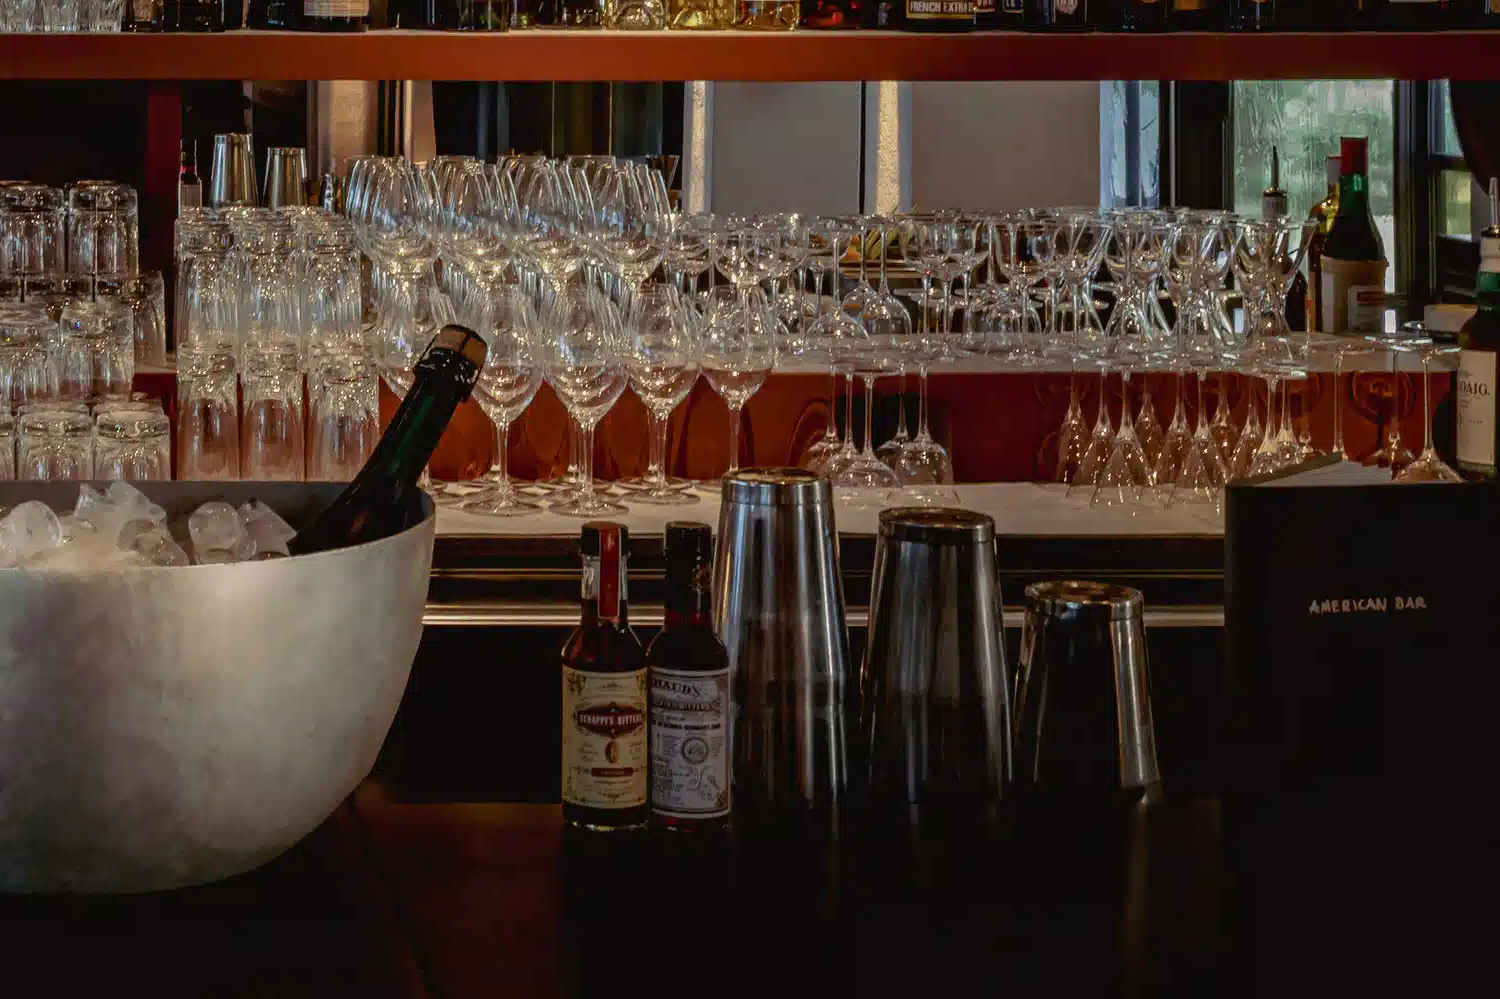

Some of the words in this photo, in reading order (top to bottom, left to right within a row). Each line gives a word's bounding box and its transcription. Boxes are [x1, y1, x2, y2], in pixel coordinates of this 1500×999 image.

[908, 1, 940, 13] FRENCH
[1308, 597, 1388, 616] AMERICAN
[1394, 595, 1427, 612] BAR
[579, 714, 614, 726] SCRAPPY'S
